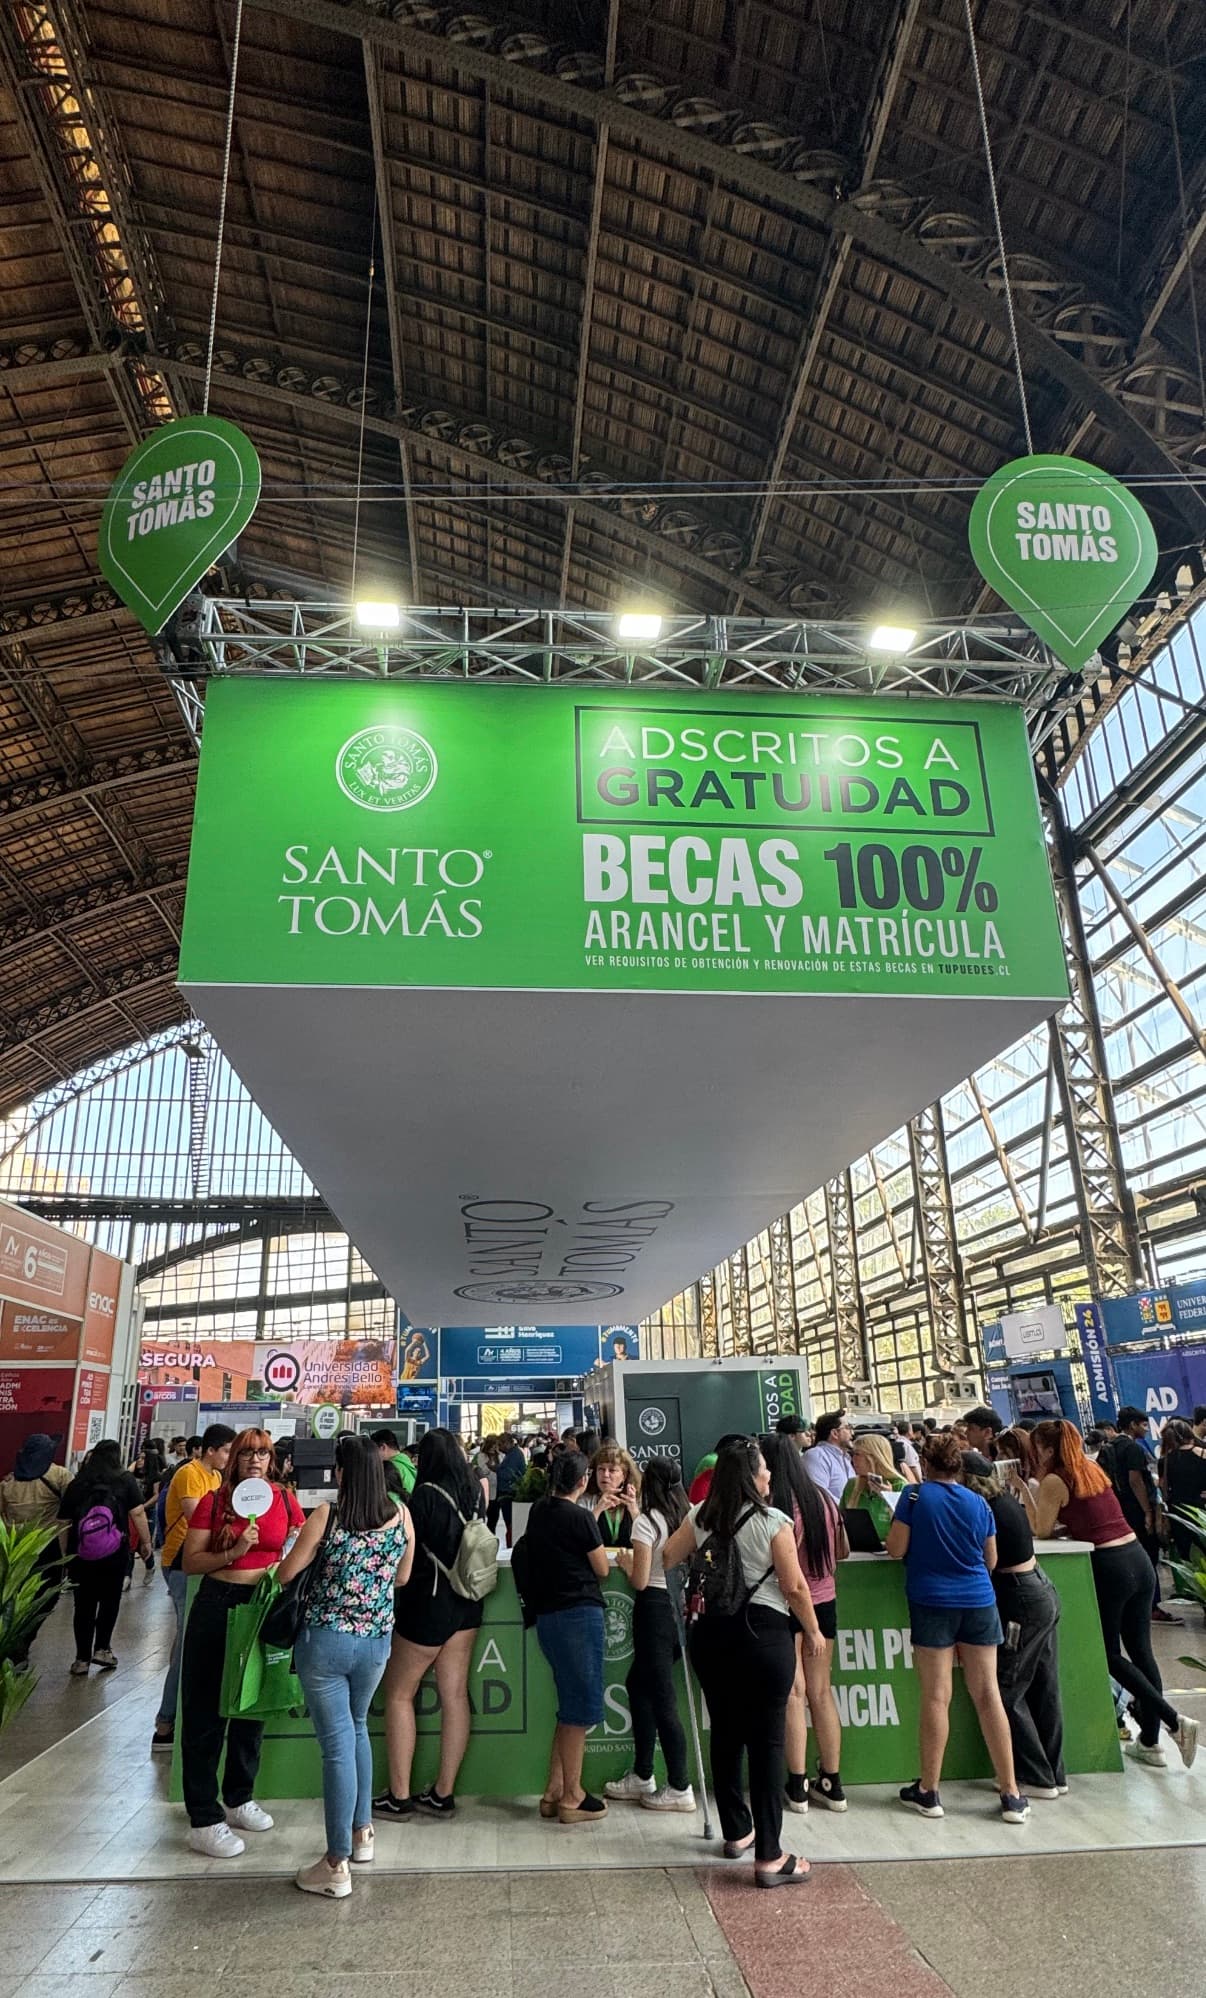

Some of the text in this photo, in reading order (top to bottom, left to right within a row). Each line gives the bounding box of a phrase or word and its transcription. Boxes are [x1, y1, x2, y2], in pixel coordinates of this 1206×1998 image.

[131, 459, 216, 510] SANTO
[127, 487, 216, 541] TOMÁS
[1017, 502, 1112, 532] SANTO
[1015, 530, 1118, 563] TOMÁS
[344, 733, 385, 770] SANTO
[600, 725, 960, 771] ADSCRITOS A
[349, 781, 421, 805] LUX ET VERITAS
[596, 767, 971, 817] GRATUIDAD
[581, 833, 999, 913] BECAS 100%
[278, 889, 483, 938] TOMÁS
[584, 909, 1006, 959] ARANCEL Y MATRÍCULA
[585, 955, 604, 966] VER
[609, 956, 670, 968] REQUISITOS
[674, 957, 687, 968] DE
[691, 956, 749, 969] OBTENCIÓN
[753, 959, 760, 970] Y
[764, 959, 828, 972] RENOVACIÓN
[832, 961, 846, 972] DE
[850, 962, 881, 973] ESTAS
[885, 962, 917, 974] BECAS
[921, 963, 934, 974] EN
[556, 1200, 675, 1277] TOMÁS
[24, 1246, 37, 1279] 6
[14, 1315, 48, 1324] ENAC
[1179, 1306, 1206, 1320] FEDERI
[139, 1353, 216, 1368] SEGURA
[304, 1361, 379, 1372] Universidad
[1086, 1328, 1108, 1403] ADMISIÓN
[352, 1372, 382, 1383] Bello
[764, 1375, 777, 1388] A
[1145, 1387, 1178, 1412] AD
[629, 1444, 681, 1458] SANTO
[477, 1638, 507, 1673] A
[837, 1628, 877, 1671] EN
